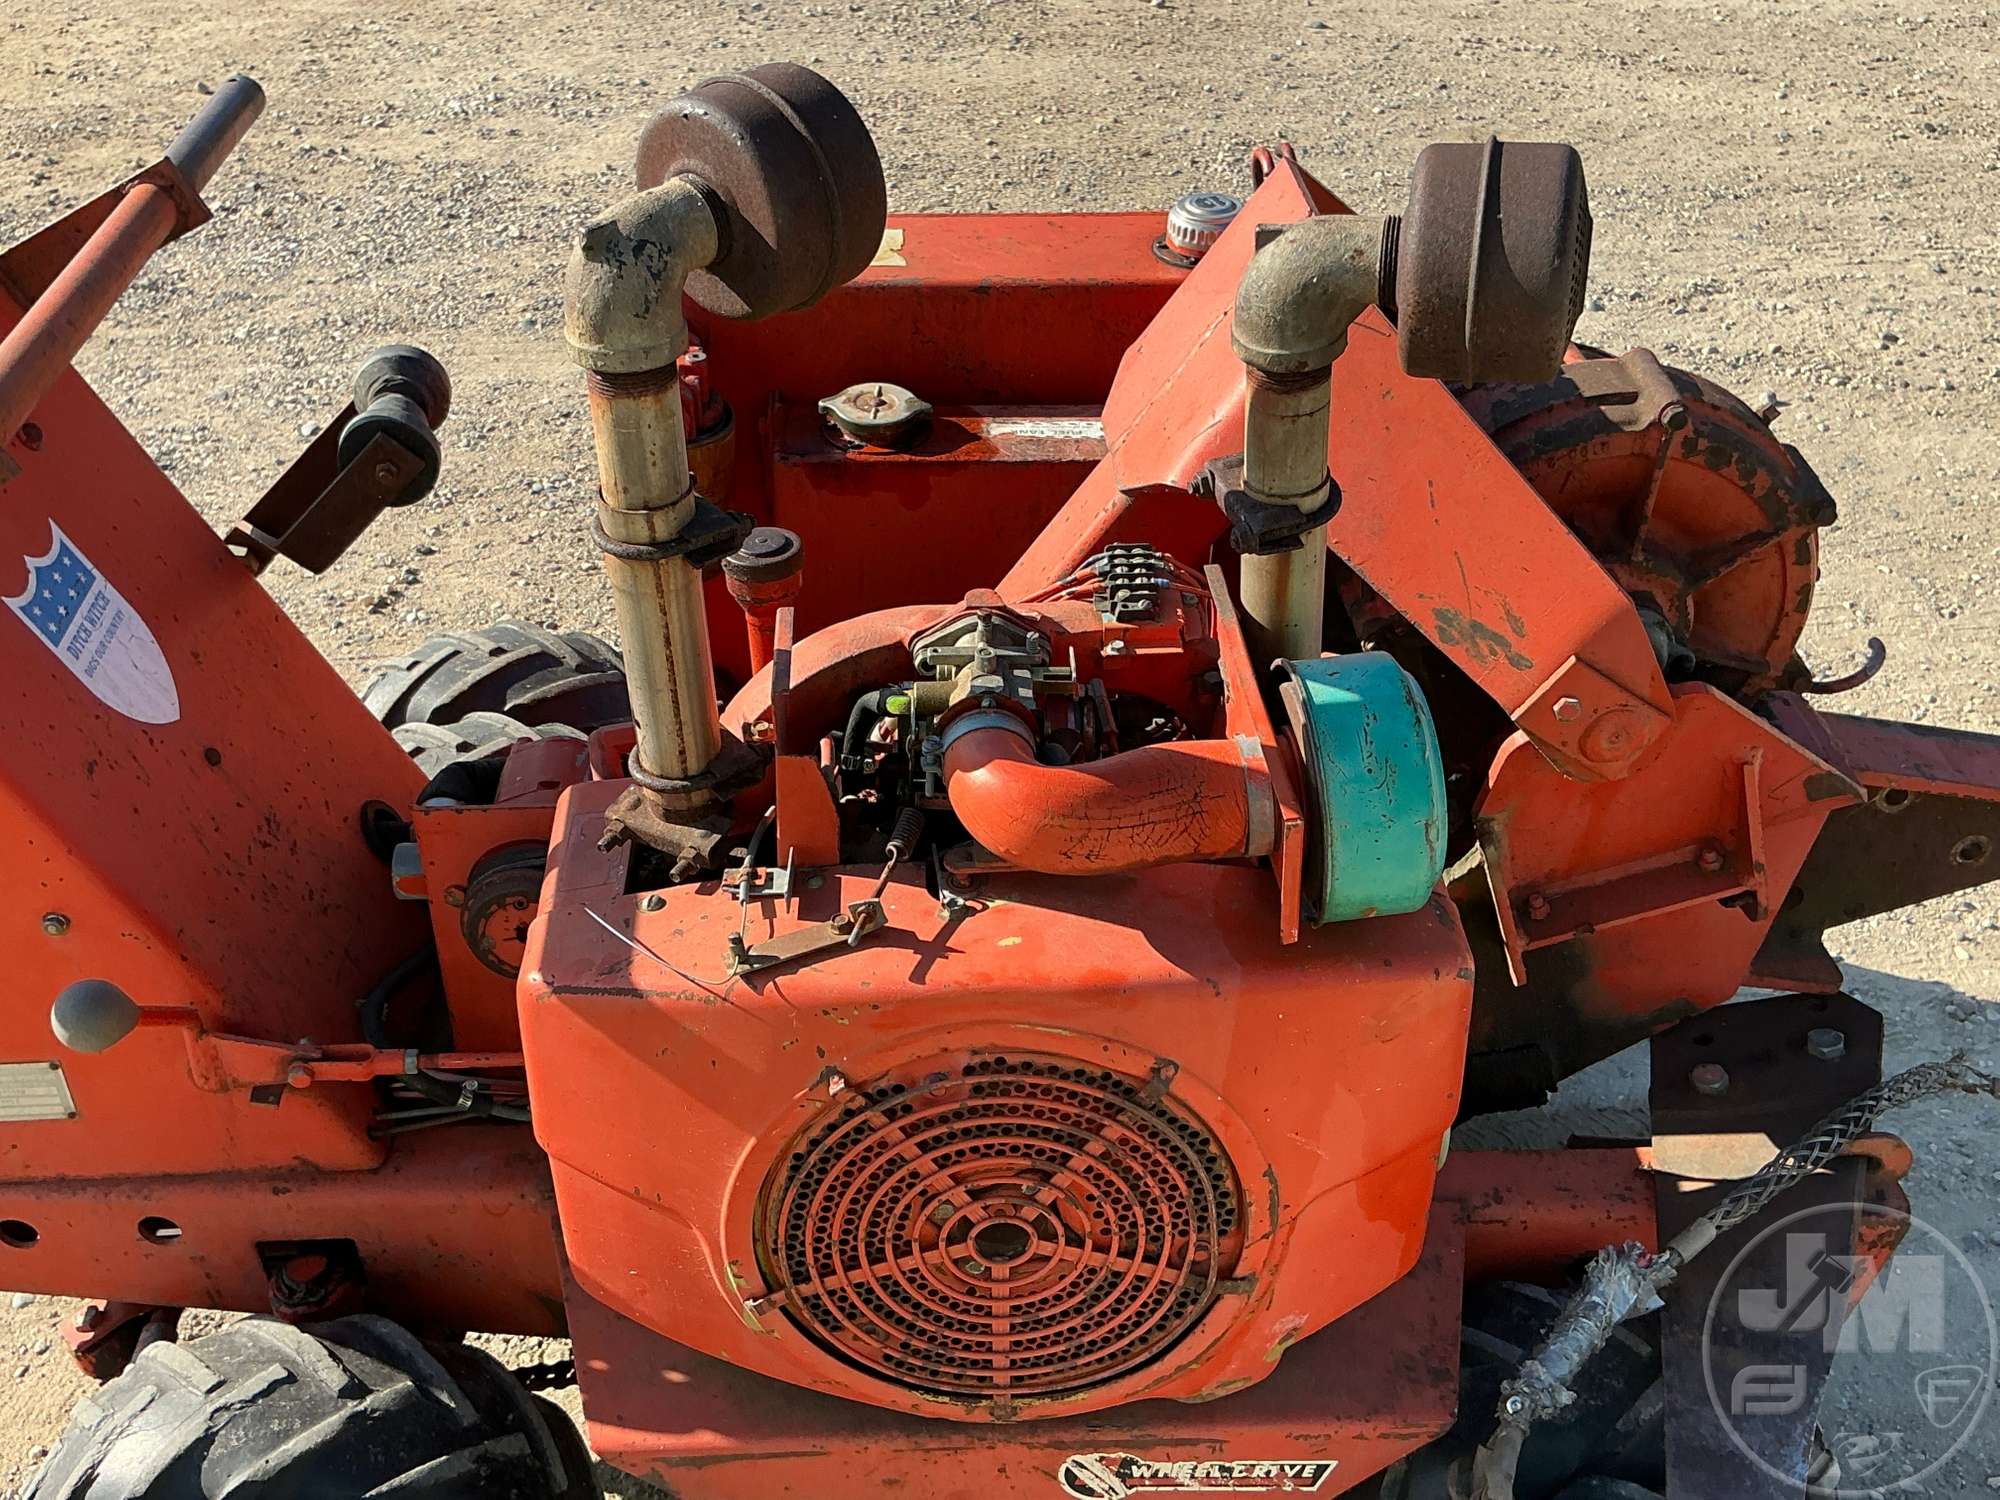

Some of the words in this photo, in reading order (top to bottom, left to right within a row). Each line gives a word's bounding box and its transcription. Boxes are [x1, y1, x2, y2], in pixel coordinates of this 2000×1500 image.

[66, 621, 93, 661] DITCH
[84, 590, 111, 628] WITCH
[84, 655, 101, 678] DIGS
[94, 640, 108, 660] OUR
[103, 609, 126, 644] COUNTRY
